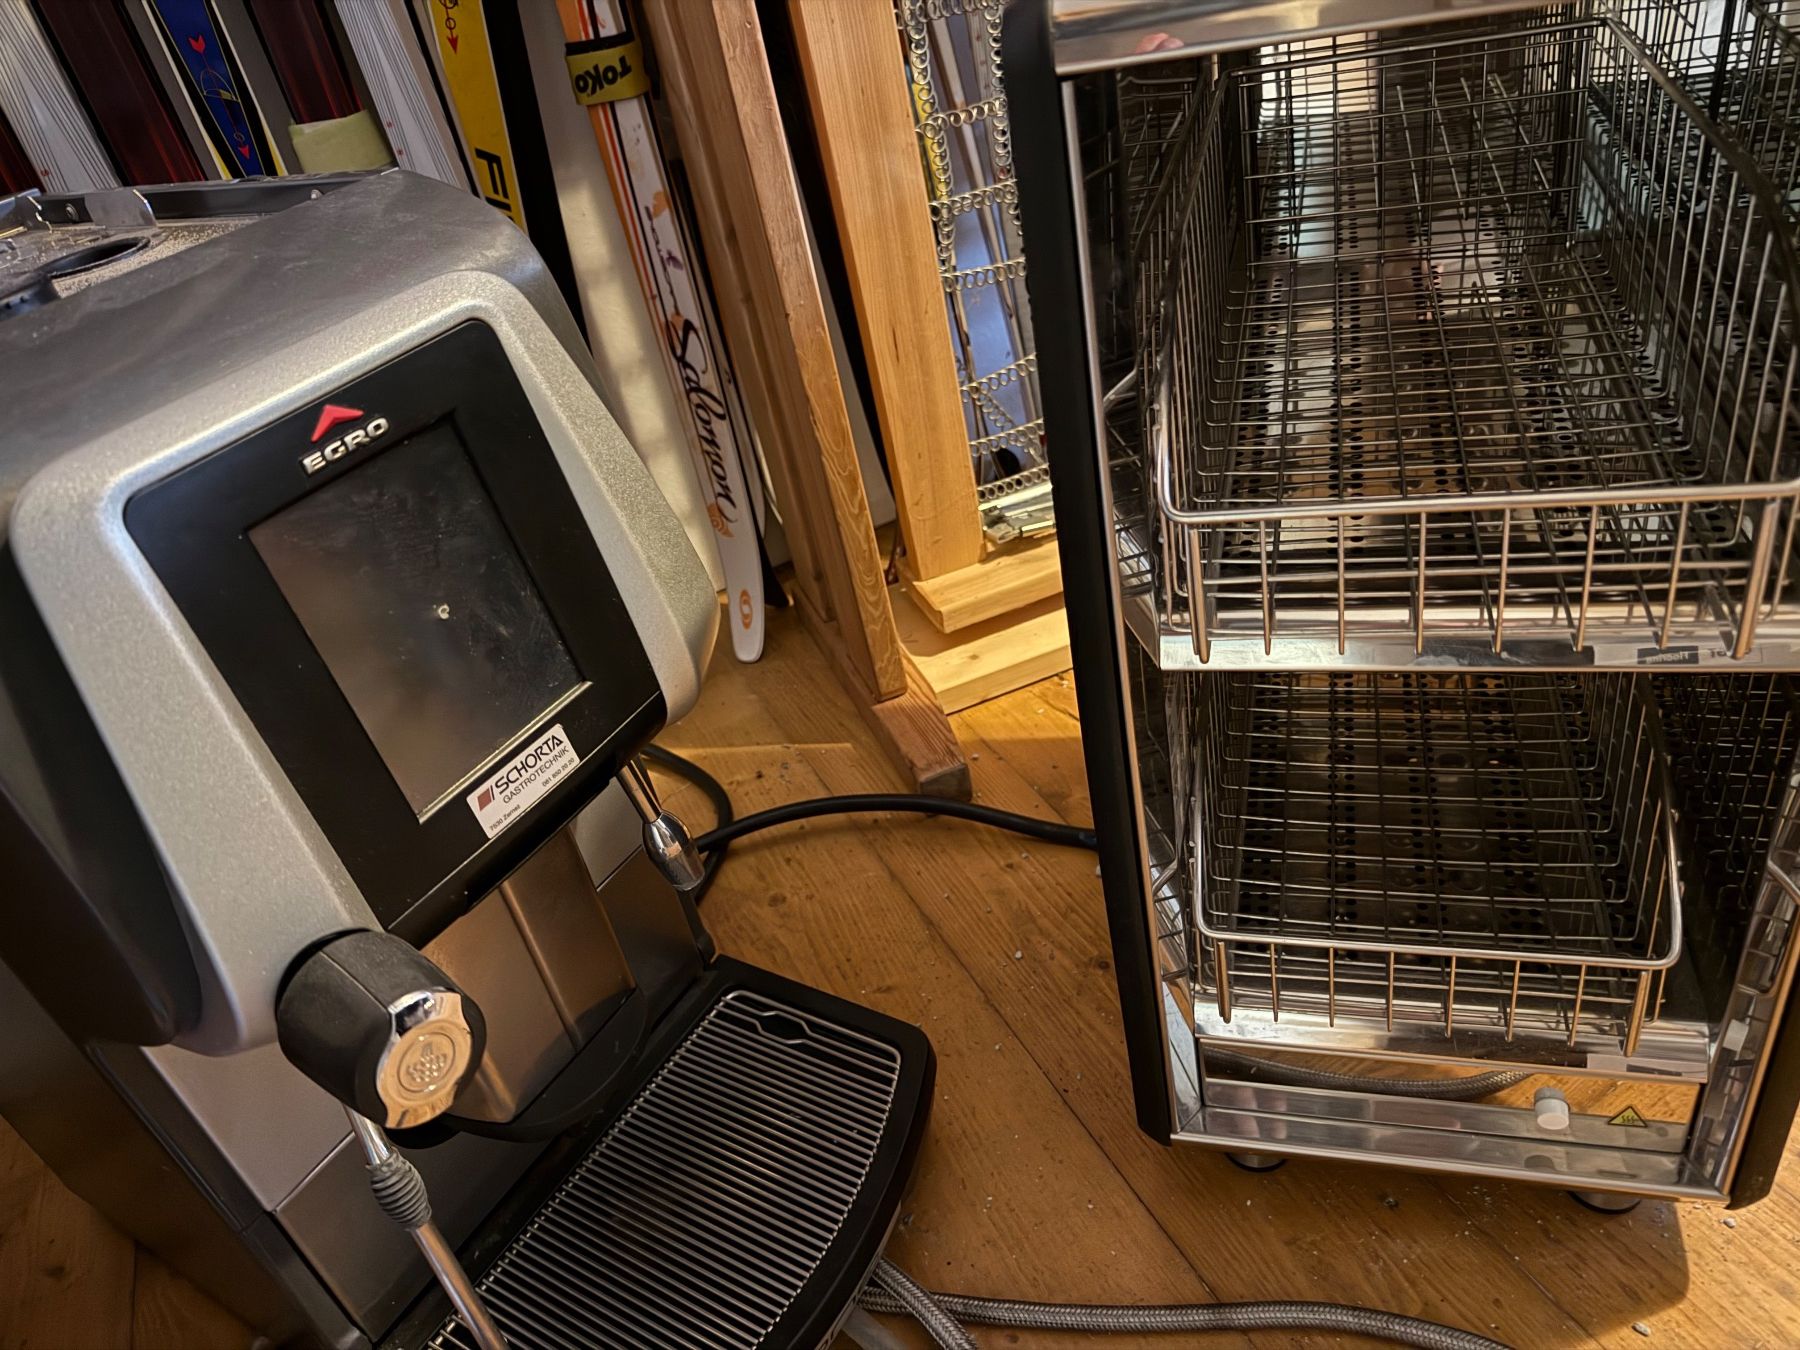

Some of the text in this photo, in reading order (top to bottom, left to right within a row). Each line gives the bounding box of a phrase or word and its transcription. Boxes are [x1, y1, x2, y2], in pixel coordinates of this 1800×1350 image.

[574, 55, 632, 96] TOKO
[475, 147, 514, 223] FI
[302, 417, 389, 475] EGRO
[667, 319, 738, 524] Salomon
[496, 735, 563, 794] SCHORTA
[503, 746, 569, 804] GASTROTECHNIK
